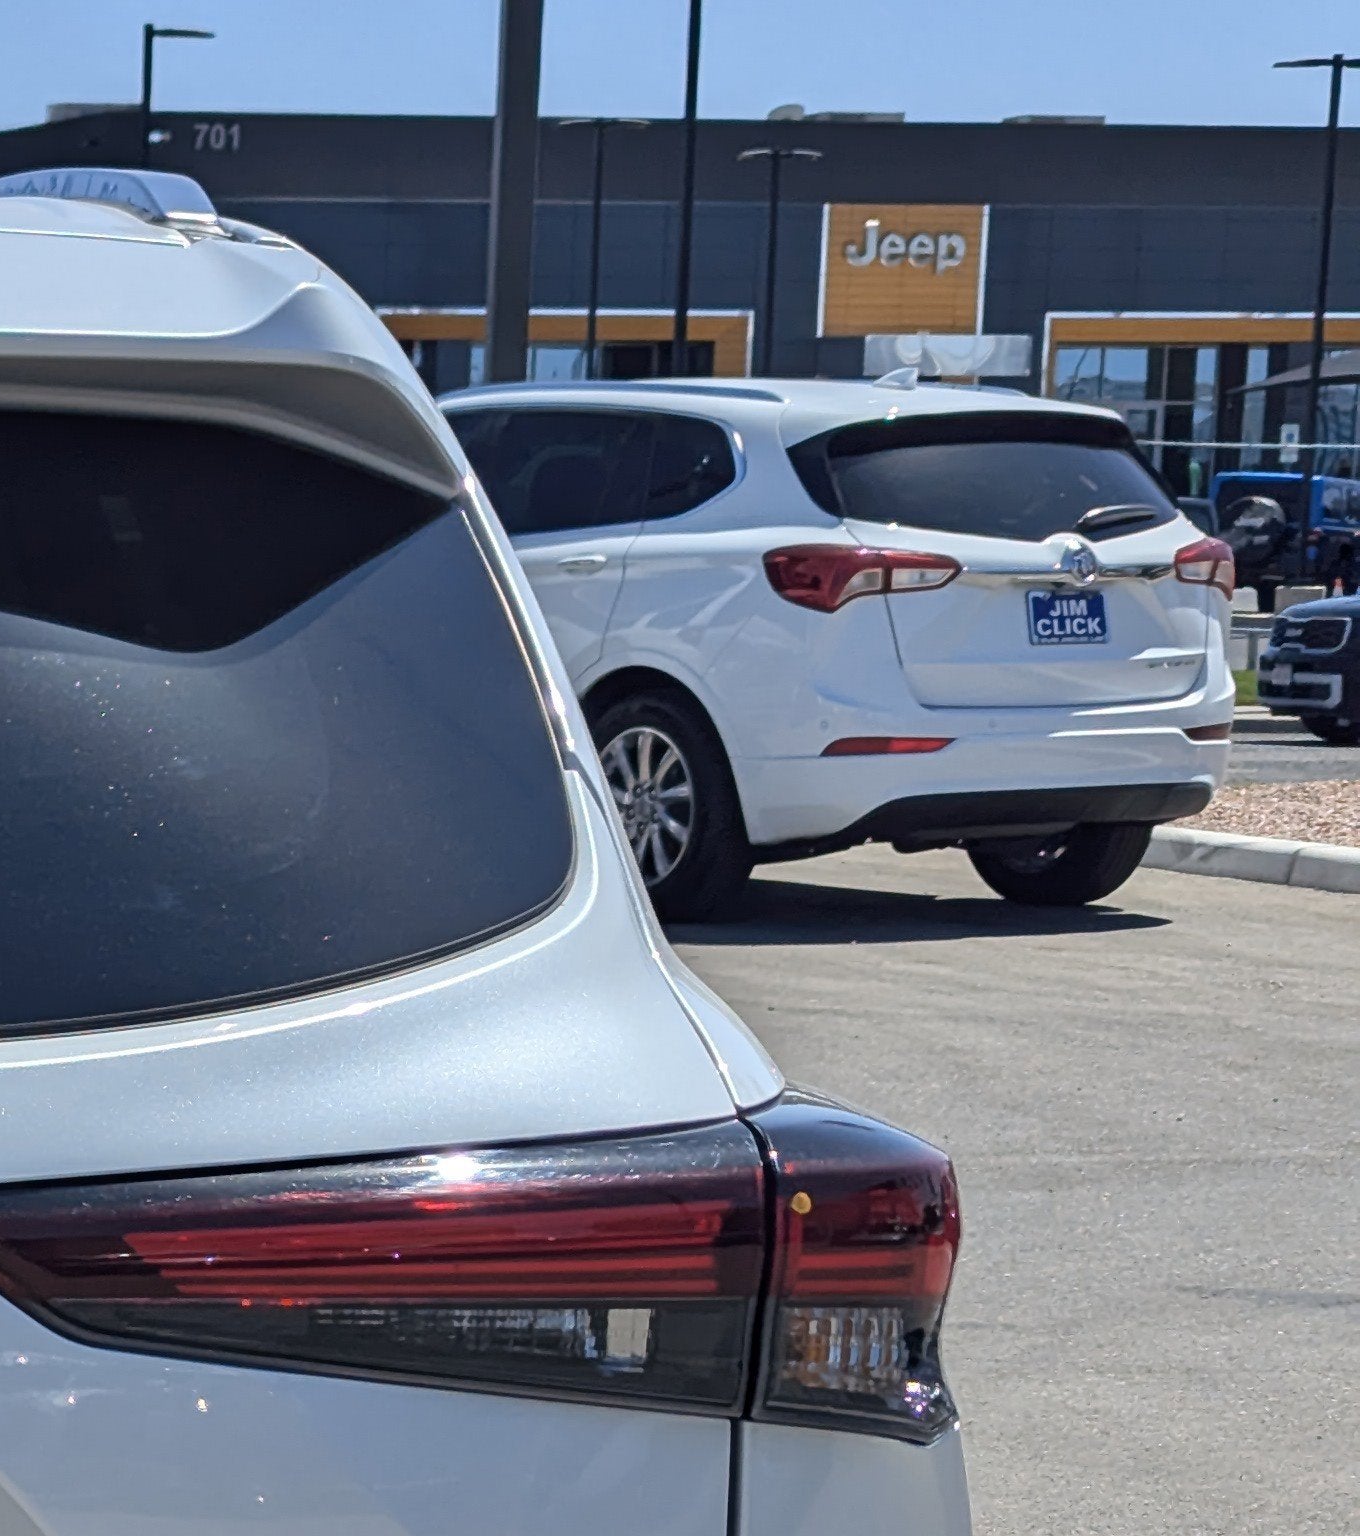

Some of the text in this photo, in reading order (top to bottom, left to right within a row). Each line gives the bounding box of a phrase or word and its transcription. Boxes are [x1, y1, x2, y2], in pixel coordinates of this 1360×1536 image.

[193, 122, 241, 151] 701
[845, 219, 966, 276] Jeep
[1049, 599, 1088, 617] JIM
[1036, 617, 1102, 636] CLICK
